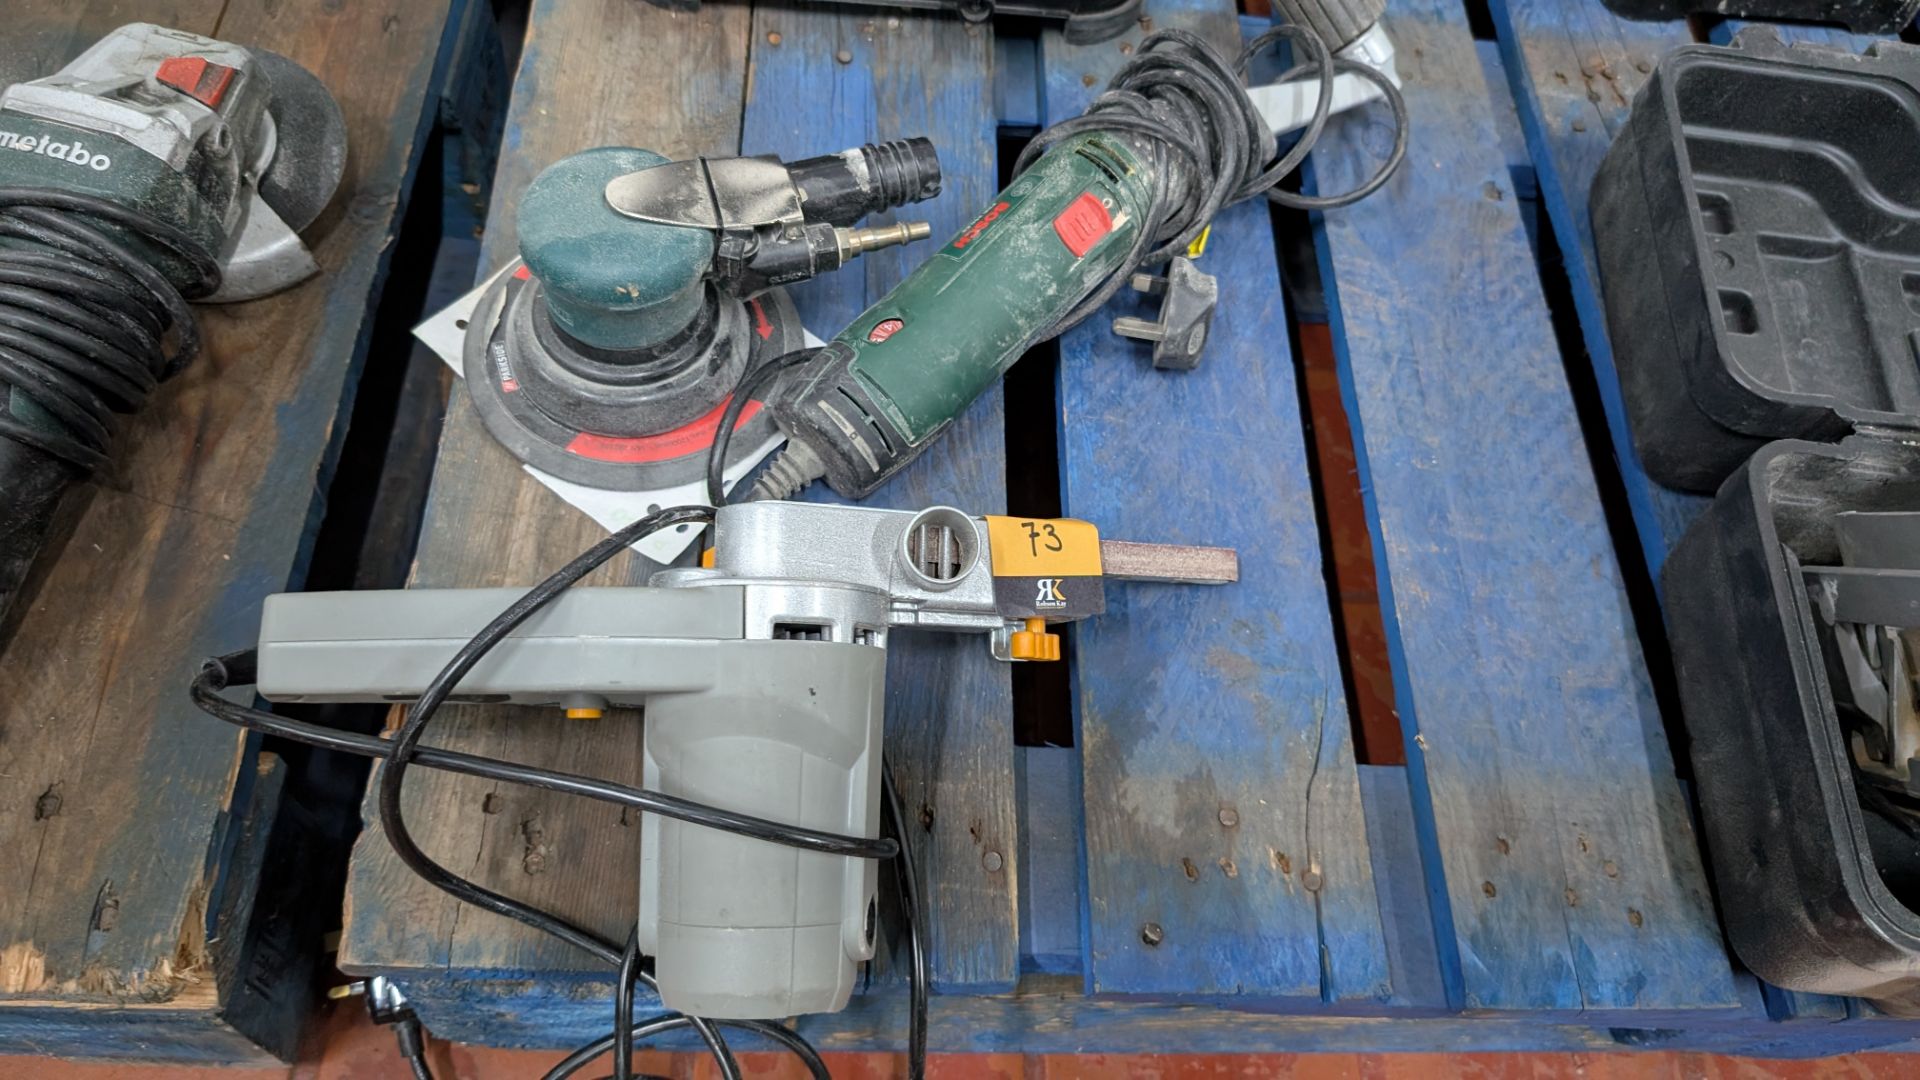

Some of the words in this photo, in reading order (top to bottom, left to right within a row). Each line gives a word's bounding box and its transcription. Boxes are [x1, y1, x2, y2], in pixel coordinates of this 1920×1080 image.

[0, 131, 111, 171] metabo
[953, 201, 1010, 249] BOSCH
[494, 344, 512, 381] PARKSIDE
[1021, 521, 1063, 557] 73
